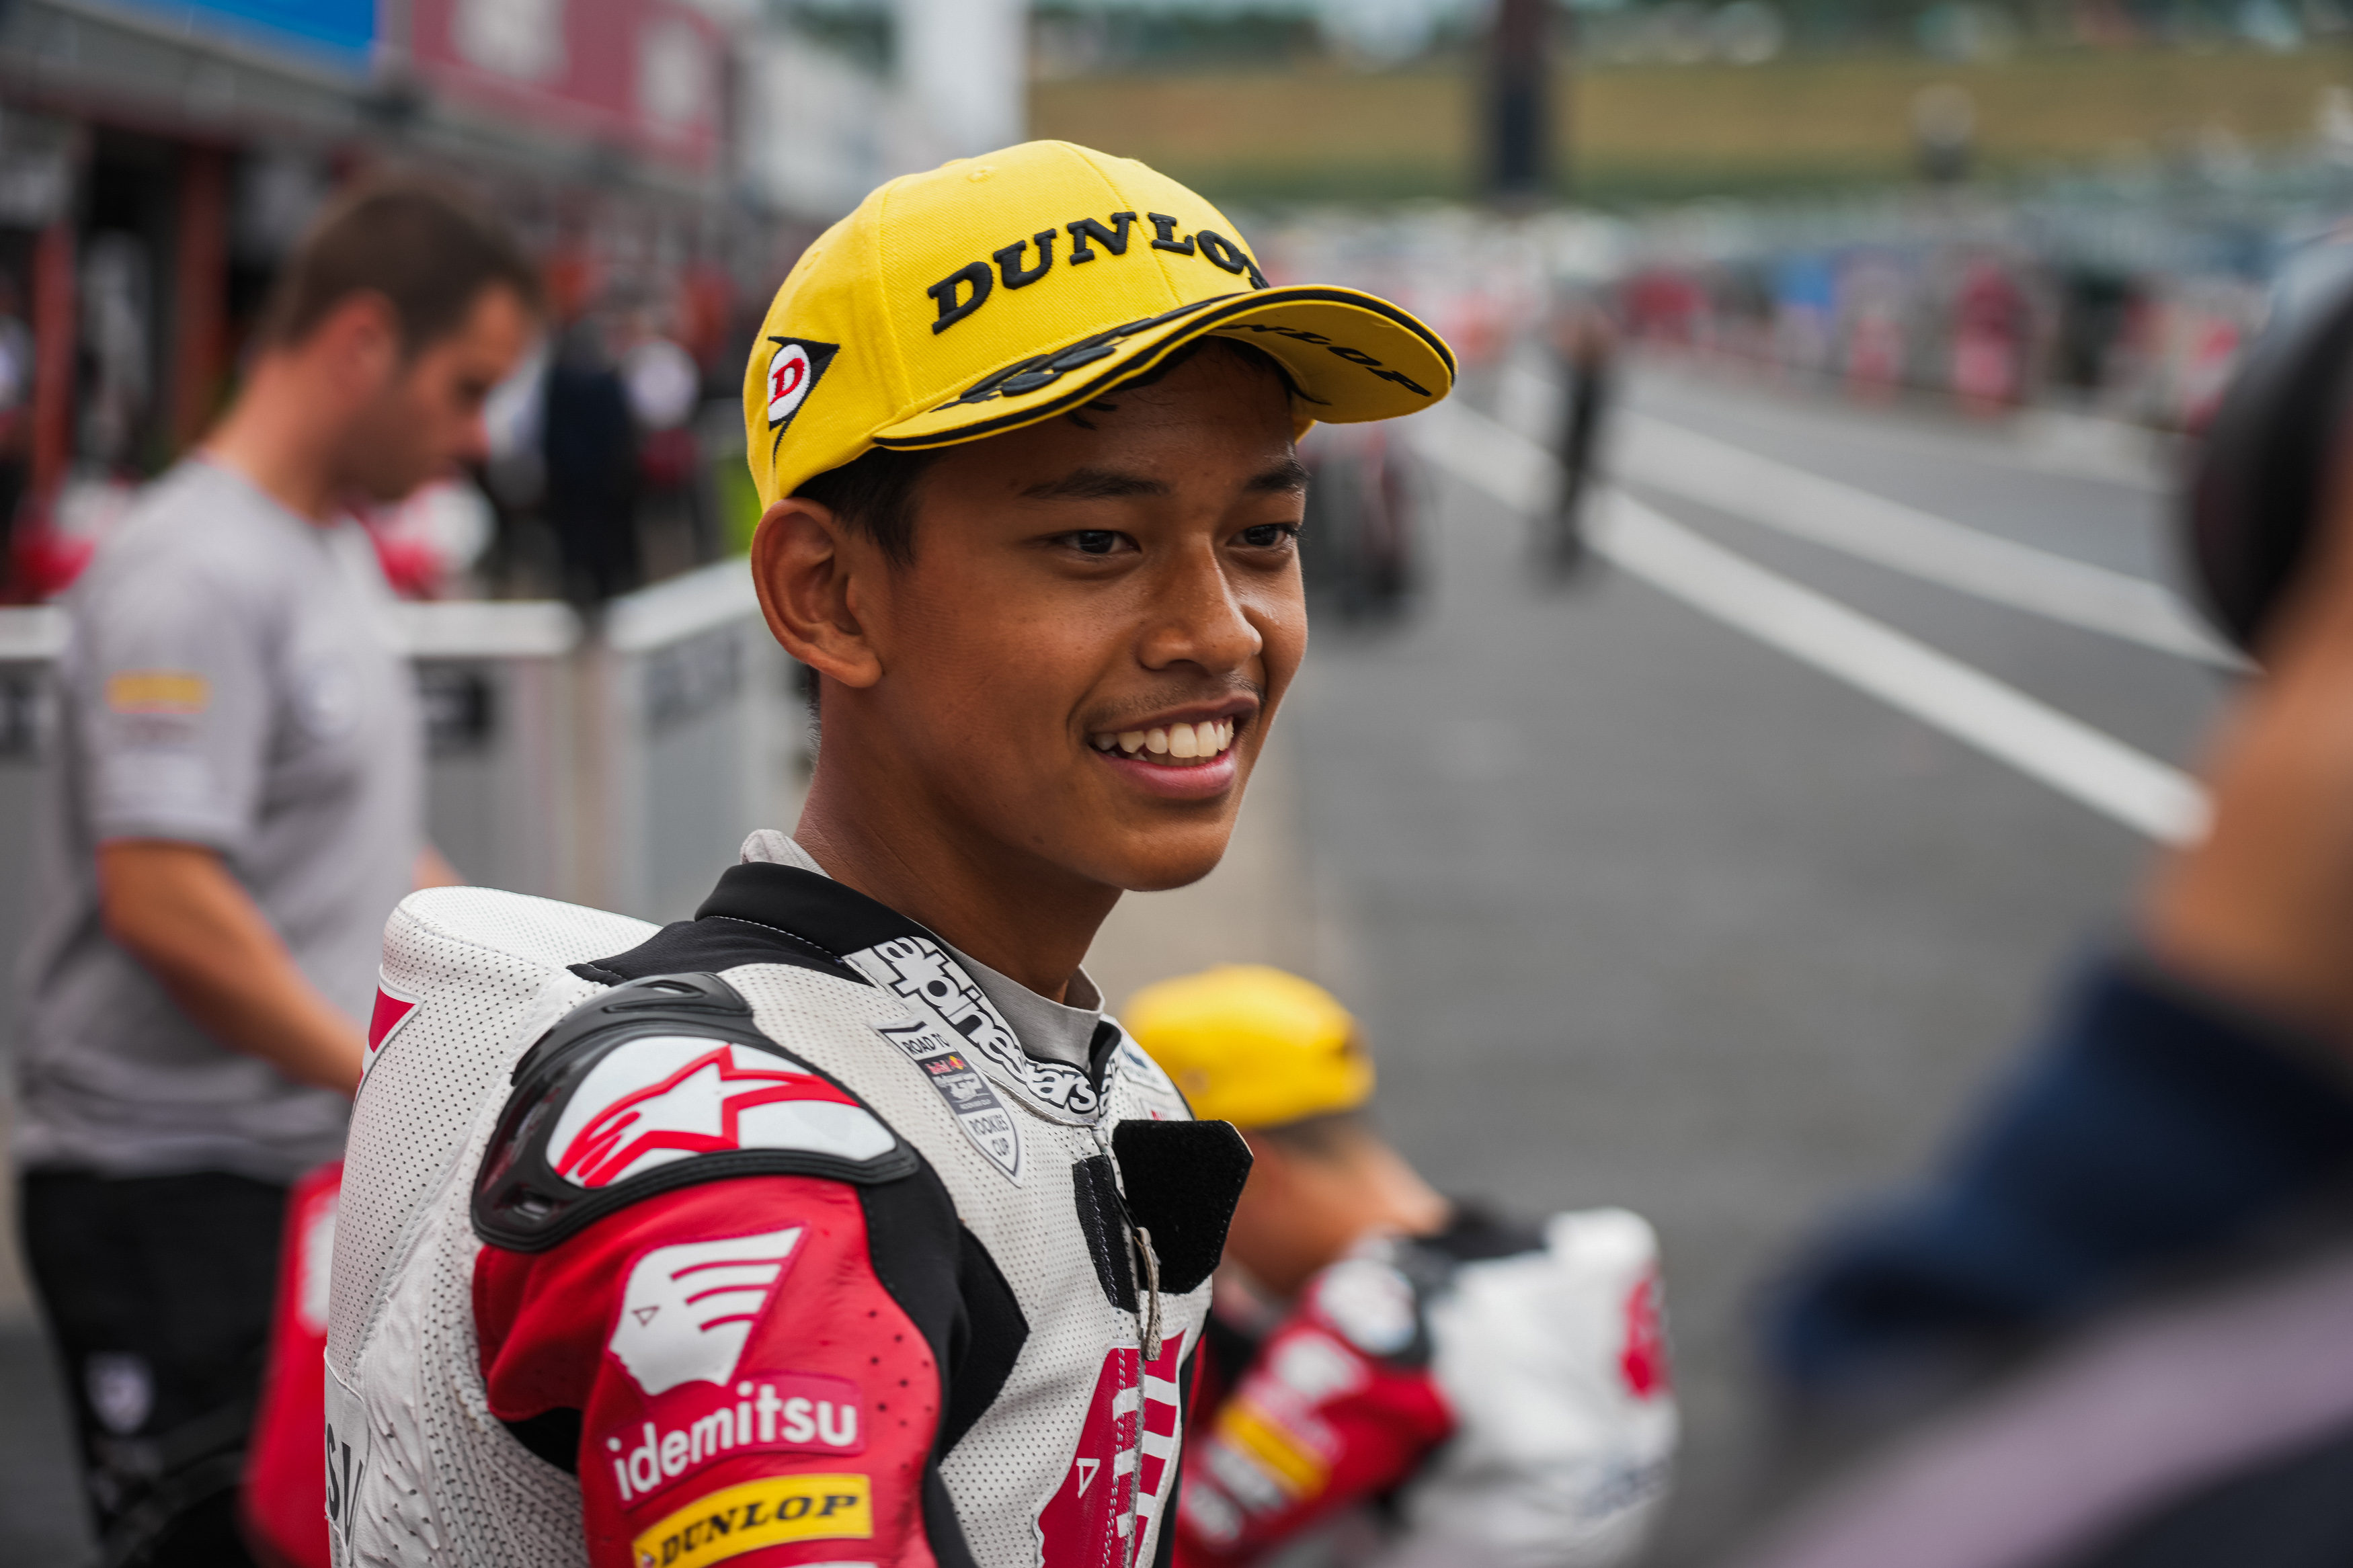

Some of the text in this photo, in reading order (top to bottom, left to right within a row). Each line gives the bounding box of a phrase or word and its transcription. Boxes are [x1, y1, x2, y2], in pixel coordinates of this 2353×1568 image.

[768, 358, 805, 407] D
[902, 1032, 951, 1055] ROAD TO
[606, 1380, 858, 1501] idemitsu
[660, 1495, 857, 1568] DUNLOP
